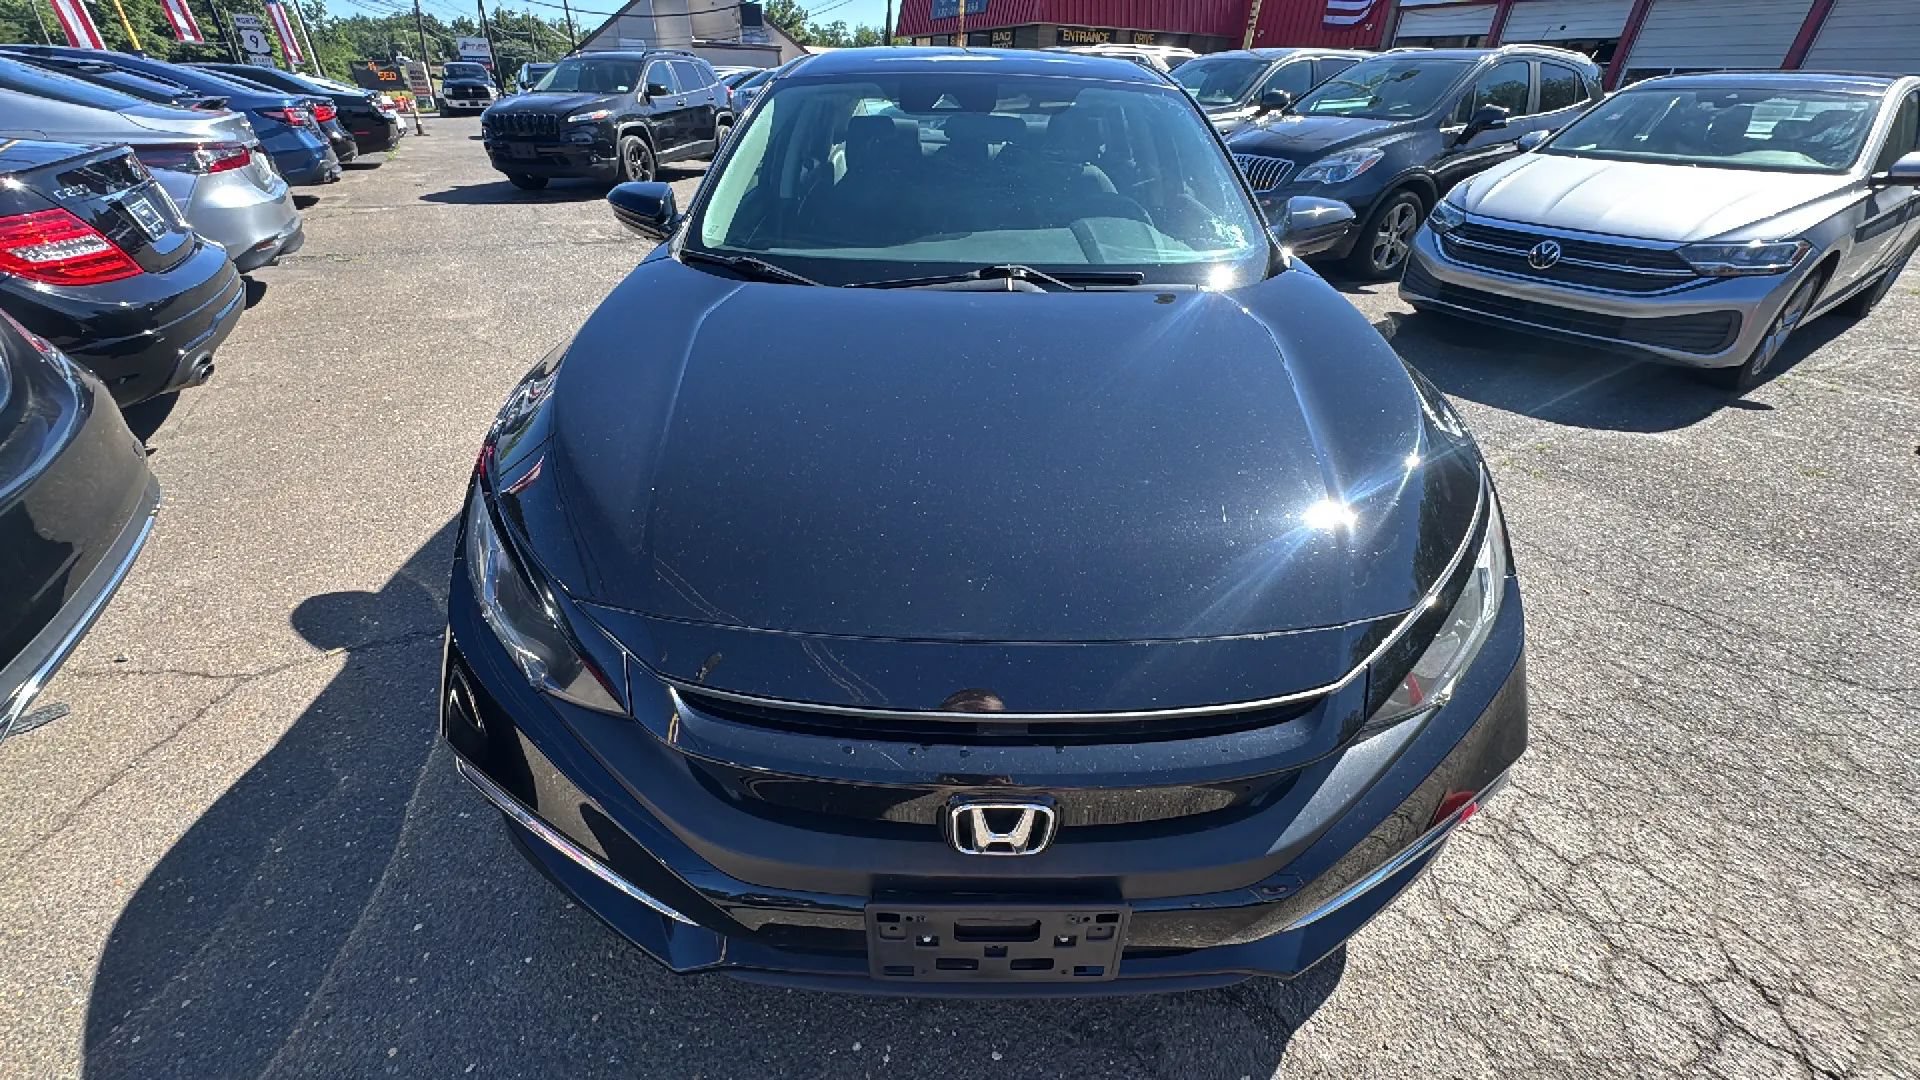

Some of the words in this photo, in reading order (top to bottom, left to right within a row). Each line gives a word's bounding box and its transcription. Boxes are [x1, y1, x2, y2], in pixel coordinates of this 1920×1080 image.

[249, 34, 259, 49] 9
[1063, 29, 1110, 43] ENTRANCE
[1133, 32, 1155, 45] DRIVE
